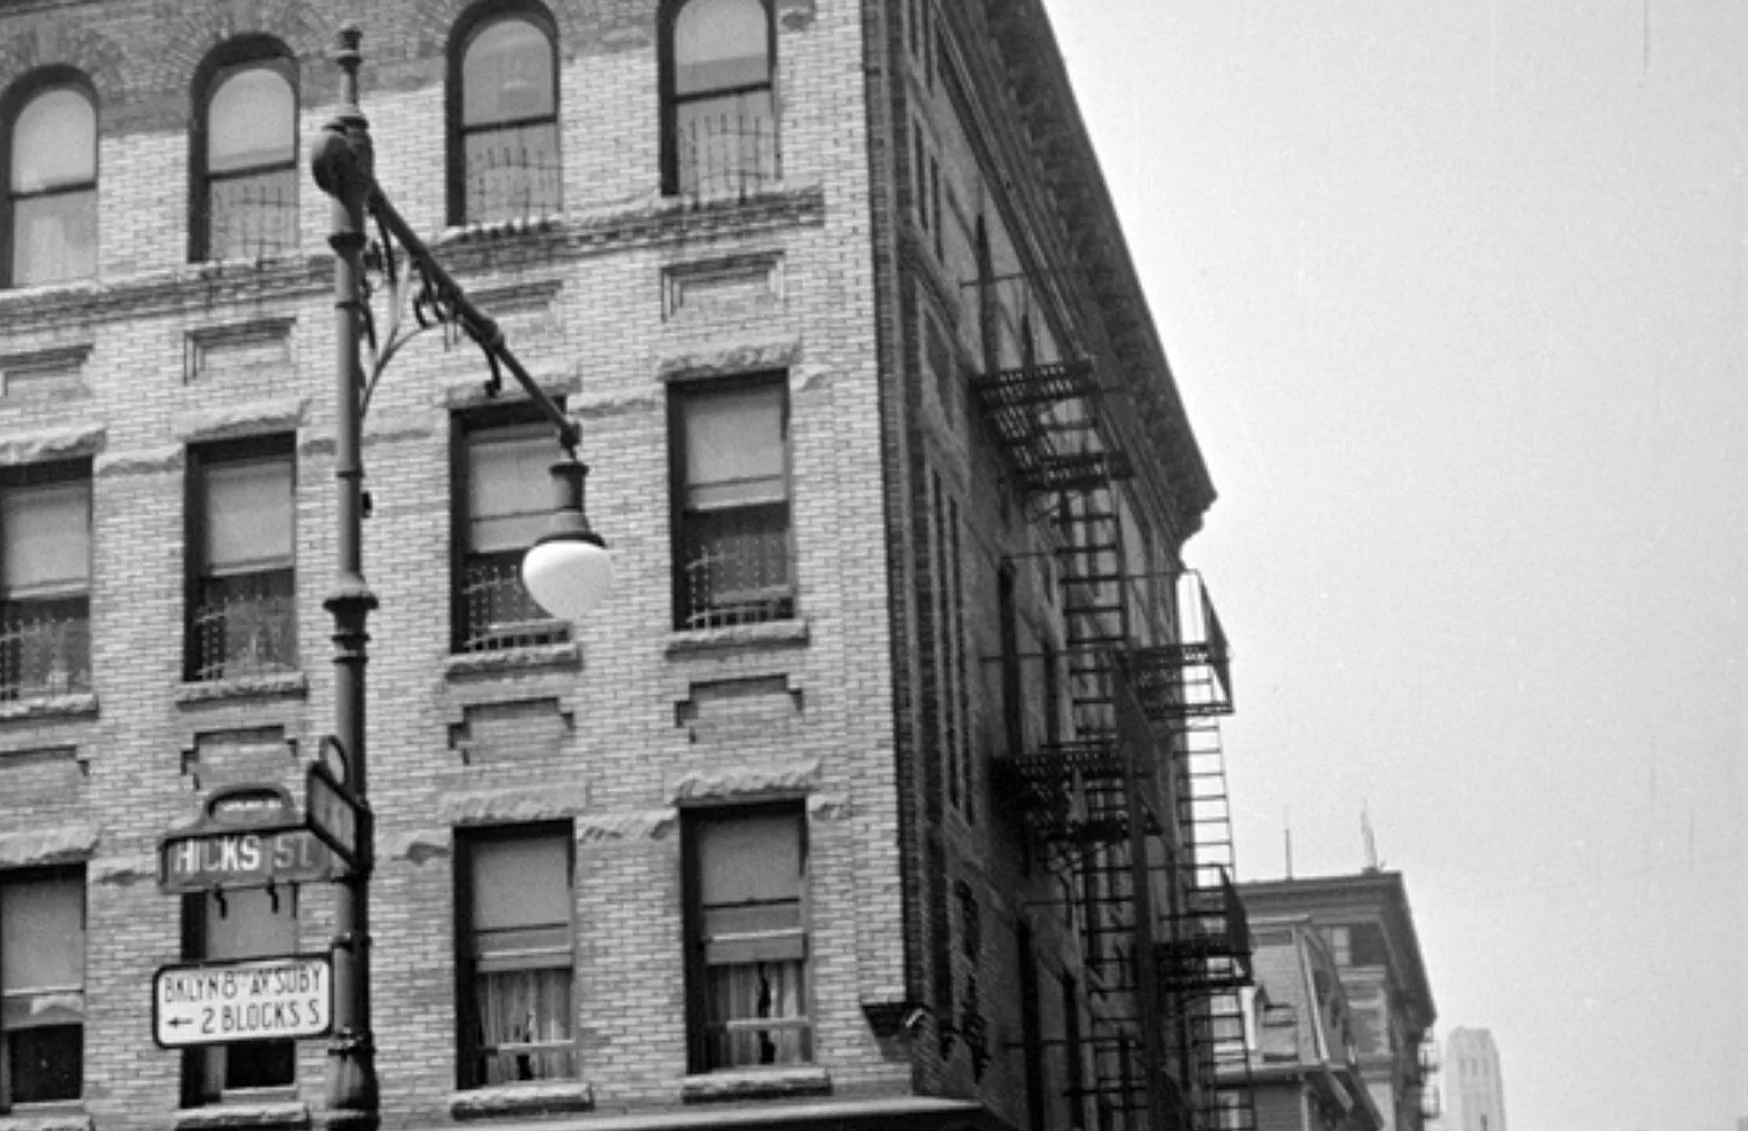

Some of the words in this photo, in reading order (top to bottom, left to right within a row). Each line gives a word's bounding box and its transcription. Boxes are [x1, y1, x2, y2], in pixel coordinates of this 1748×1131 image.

[174, 835, 260, 873] HICKS
[201, 1008, 216, 1035] 2
[221, 1001, 301, 1033] BLOCKS
[308, 998, 320, 1026] S
